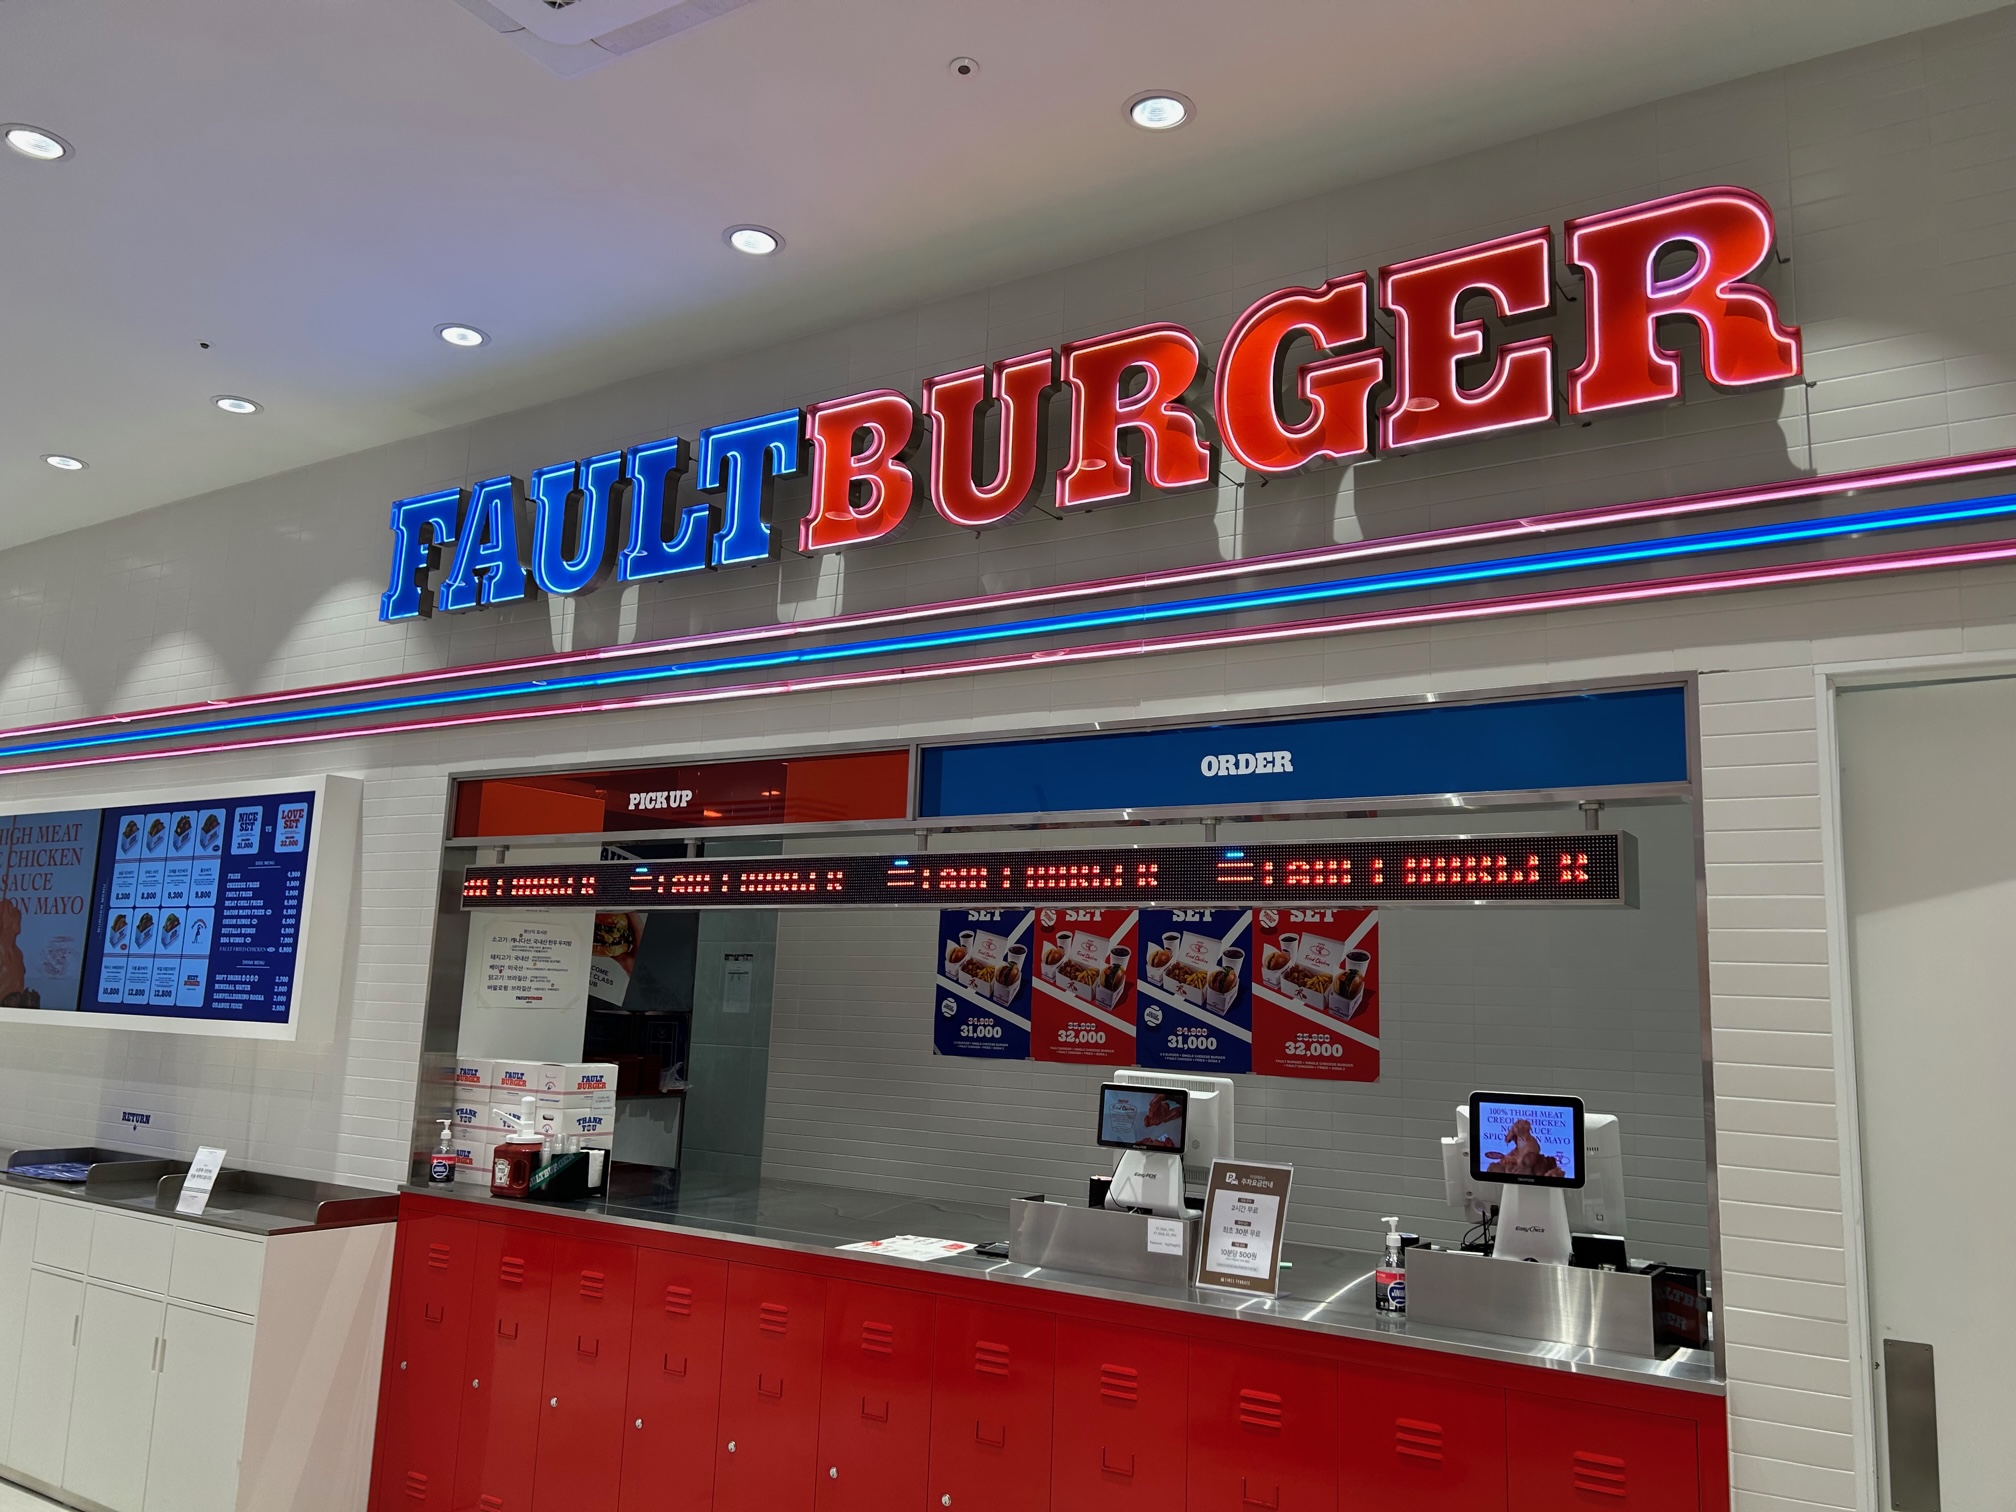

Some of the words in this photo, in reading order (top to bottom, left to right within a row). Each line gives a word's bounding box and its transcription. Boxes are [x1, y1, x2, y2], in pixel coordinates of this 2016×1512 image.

[1201, 750, 1293, 777] ORDER
[628, 791, 668, 810] PICK
[670, 790, 692, 808] UP
[238, 812, 258, 822] NICE
[281, 808, 304, 820] LOVE
[240, 822, 256, 832] SET
[283, 818, 300, 830] SET
[36, 824, 82, 843] MEAT
[8, 848, 84, 868] CHICKEN
[0, 873, 54, 892] SAUCE
[34, 896, 84, 915] MAYO
[968, 910, 1004, 921] SET
[1066, 910, 1104, 922] SET
[1172, 910, 1215, 922] SET
[1290, 909, 1337, 922] SET
[593, 974, 614, 986] CLASS
[960, 1025, 1002, 1039] 31,000
[1058, 1030, 1106, 1044] 32,000
[1168, 1036, 1217, 1050] 31,000
[1285, 1041, 1343, 1057] 32,000
[460, 1068, 478, 1077] FAULT
[504, 1071, 524, 1080] FAULT
[456, 1074, 481, 1084] BURGER
[501, 1077, 527, 1088] BURGER
[581, 1075, 604, 1083] FAULT
[577, 1082, 607, 1090] BURGER
[122, 1112, 151, 1124] RETURN
[456, 1108, 477, 1118] THANK
[1490, 1108, 1508, 1116] 100%
[1509, 1109, 1537, 1117] THIGH
[1540, 1111, 1564, 1119] MEAT
[459, 1115, 472, 1124] YOU
[576, 1116, 603, 1126] THANK
[582, 1124, 597, 1132] YOU
[1134, 1172, 1157, 1181] EasyPOS
[1241, 1178, 1274, 1188] 주차요금안내
[1231, 1205, 1246, 1214] 2시간
[1248, 1206, 1258, 1214] 무료
[1223, 1226, 1234, 1234] 최초
[1235, 1227, 1248, 1237] 30분
[1250, 1229, 1261, 1237] 무료
[1221, 1248, 1238, 1258] 10분당
[1239, 1250, 1257, 1260] 500원
